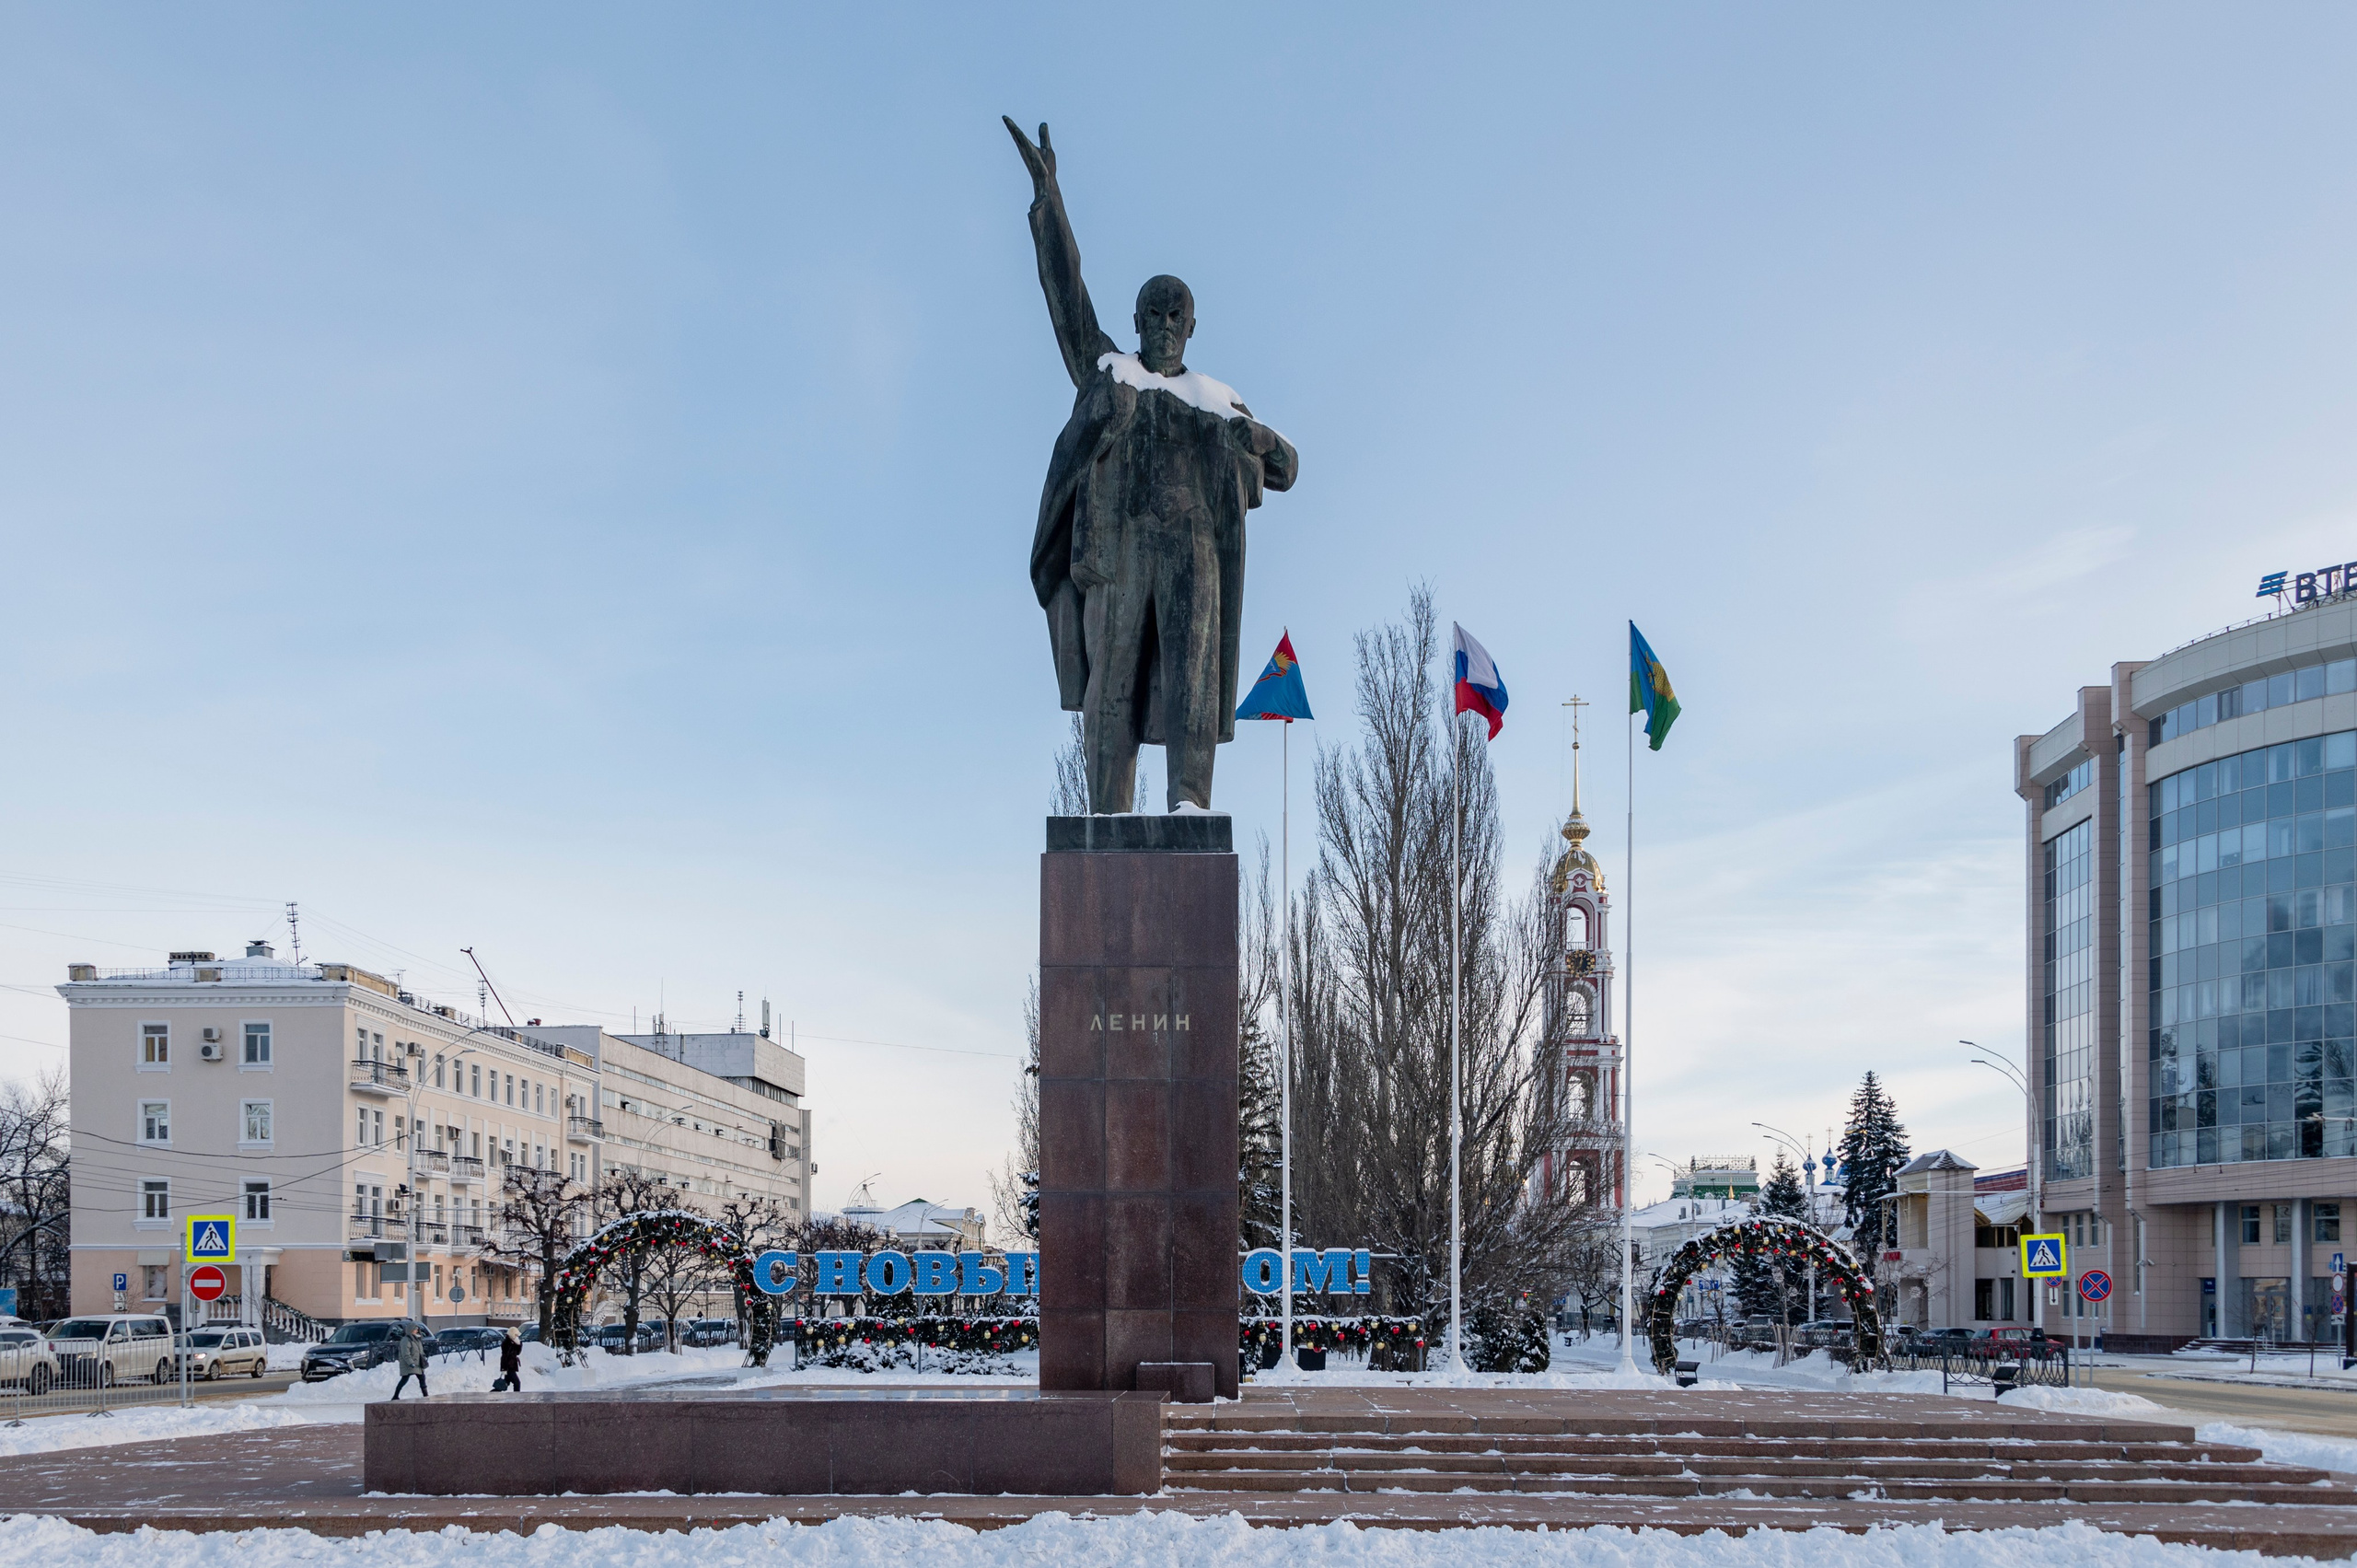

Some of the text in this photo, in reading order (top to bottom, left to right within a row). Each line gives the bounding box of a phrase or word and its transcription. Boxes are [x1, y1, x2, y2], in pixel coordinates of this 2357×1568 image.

[1090, 1014, 1190, 1031] ЛЕНИН
[753, 1248, 1370, 1295] С НОВЫ ОМ!
[116, 1275, 124, 1289] P
